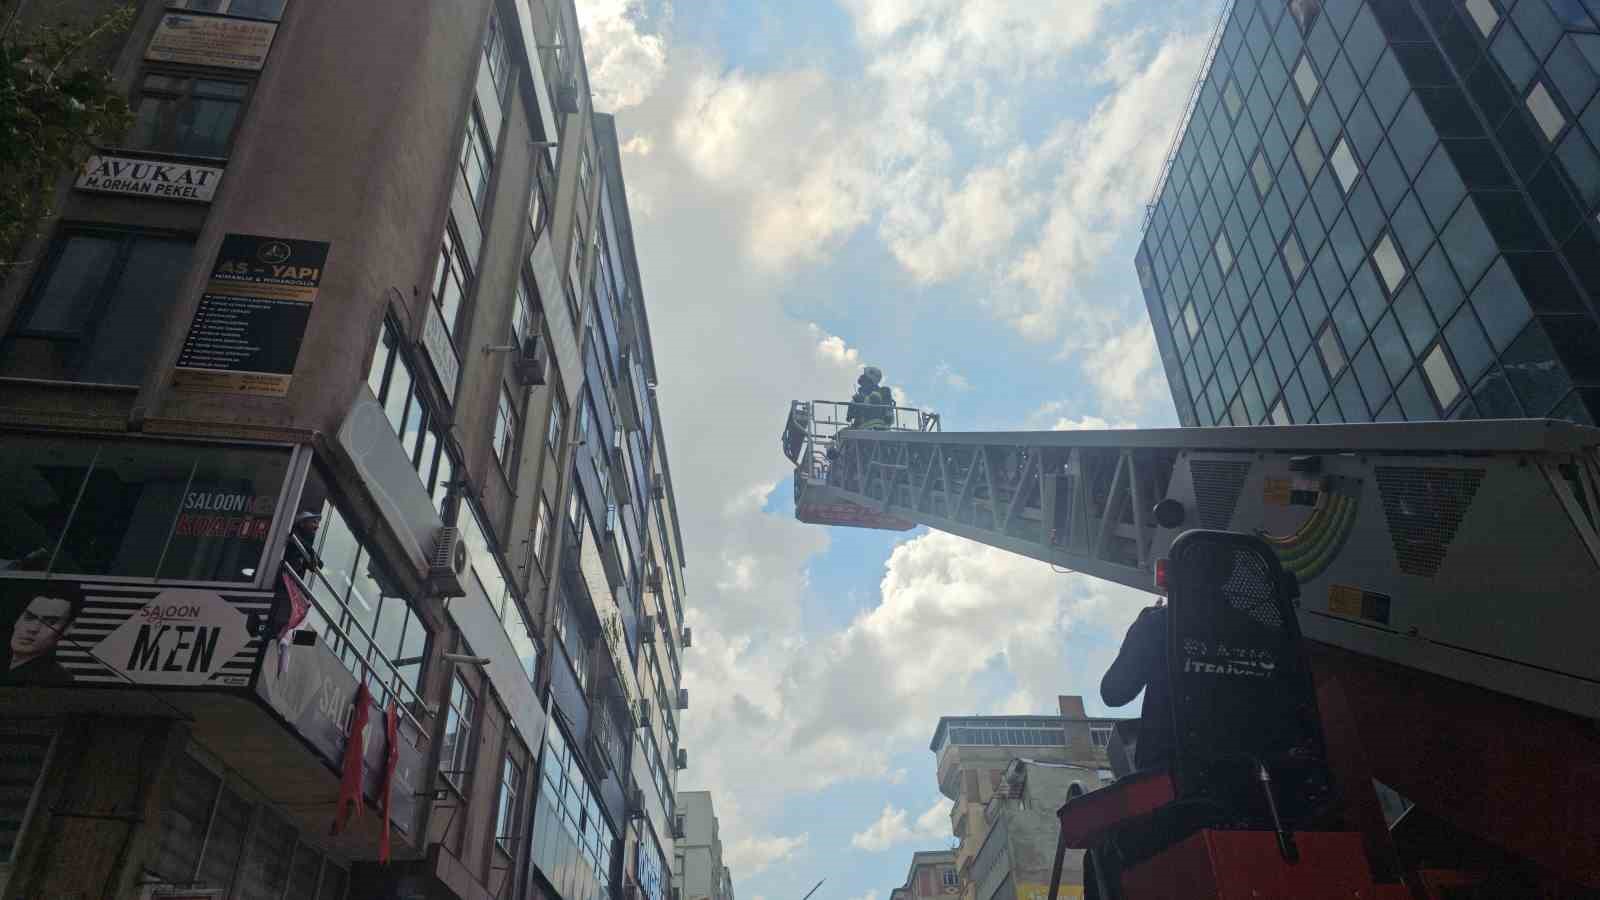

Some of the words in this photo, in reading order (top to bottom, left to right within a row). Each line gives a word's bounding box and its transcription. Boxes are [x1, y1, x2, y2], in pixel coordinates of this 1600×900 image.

[94, 161, 215, 186] AVUKAT
[102, 179, 152, 193] ORHAN
[155, 183, 199, 198] PEKEL
[272, 265, 319, 280] YAPI
[185, 492, 246, 511] SALOON
[128, 624, 220, 673] MEN
